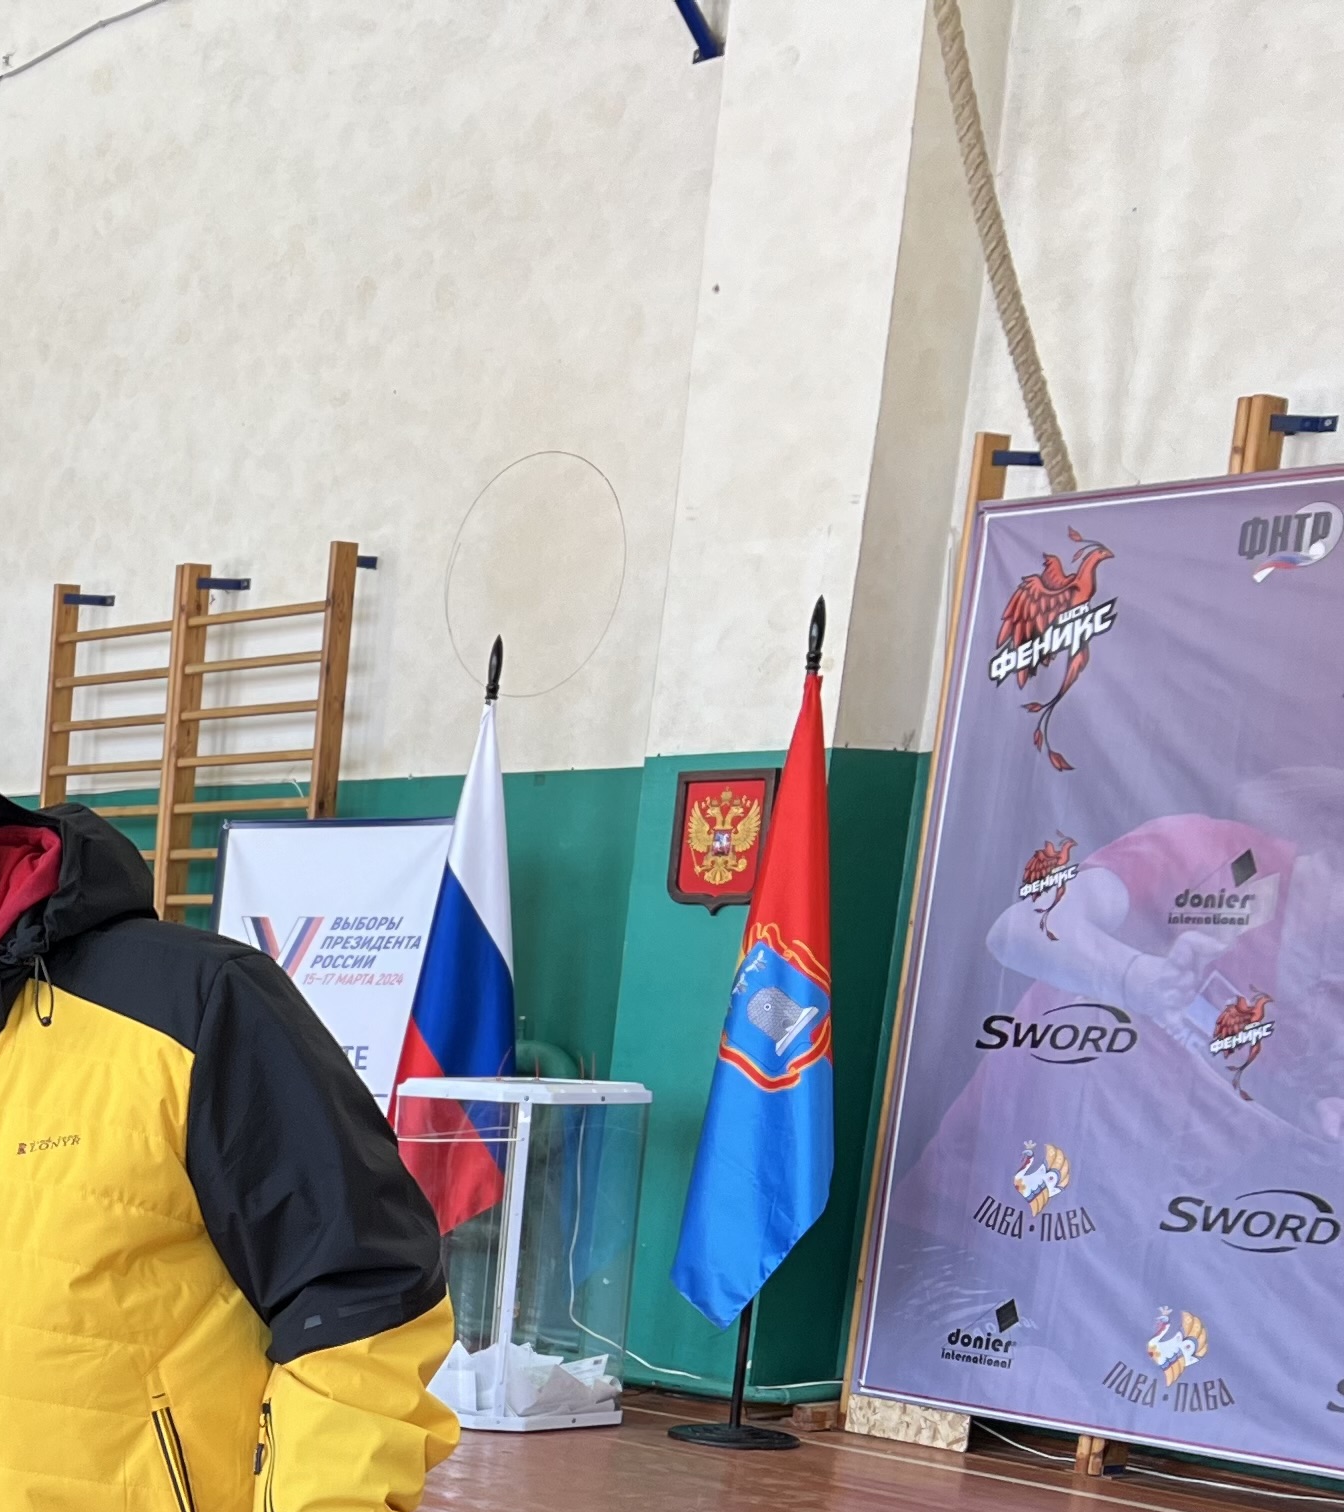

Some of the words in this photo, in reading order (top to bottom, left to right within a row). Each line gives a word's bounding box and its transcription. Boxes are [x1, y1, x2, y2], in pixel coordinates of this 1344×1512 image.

[1238, 510, 1333, 560] ФНТР
[990, 602, 1113, 680] ФЕНИКС
[1019, 866, 1076, 897] ФЕНИКС
[1174, 887, 1253, 909] donier
[330, 916, 404, 931] ВЫБОРЫ
[1167, 912, 1250, 925] international
[320, 935, 422, 952] ПРЕЗИДЕНТА
[310, 954, 377, 969] РОССИИ
[336, 973, 374, 986] МАРТА
[375, 973, 404, 986] 2024
[975, 1014, 1138, 1053] SWORD
[1210, 1023, 1272, 1053] ФЕНИКС
[1159, 1195, 1341, 1245] SWORD
[947, 1328, 1012, 1353] donier
[940, 1347, 1013, 1369] international
